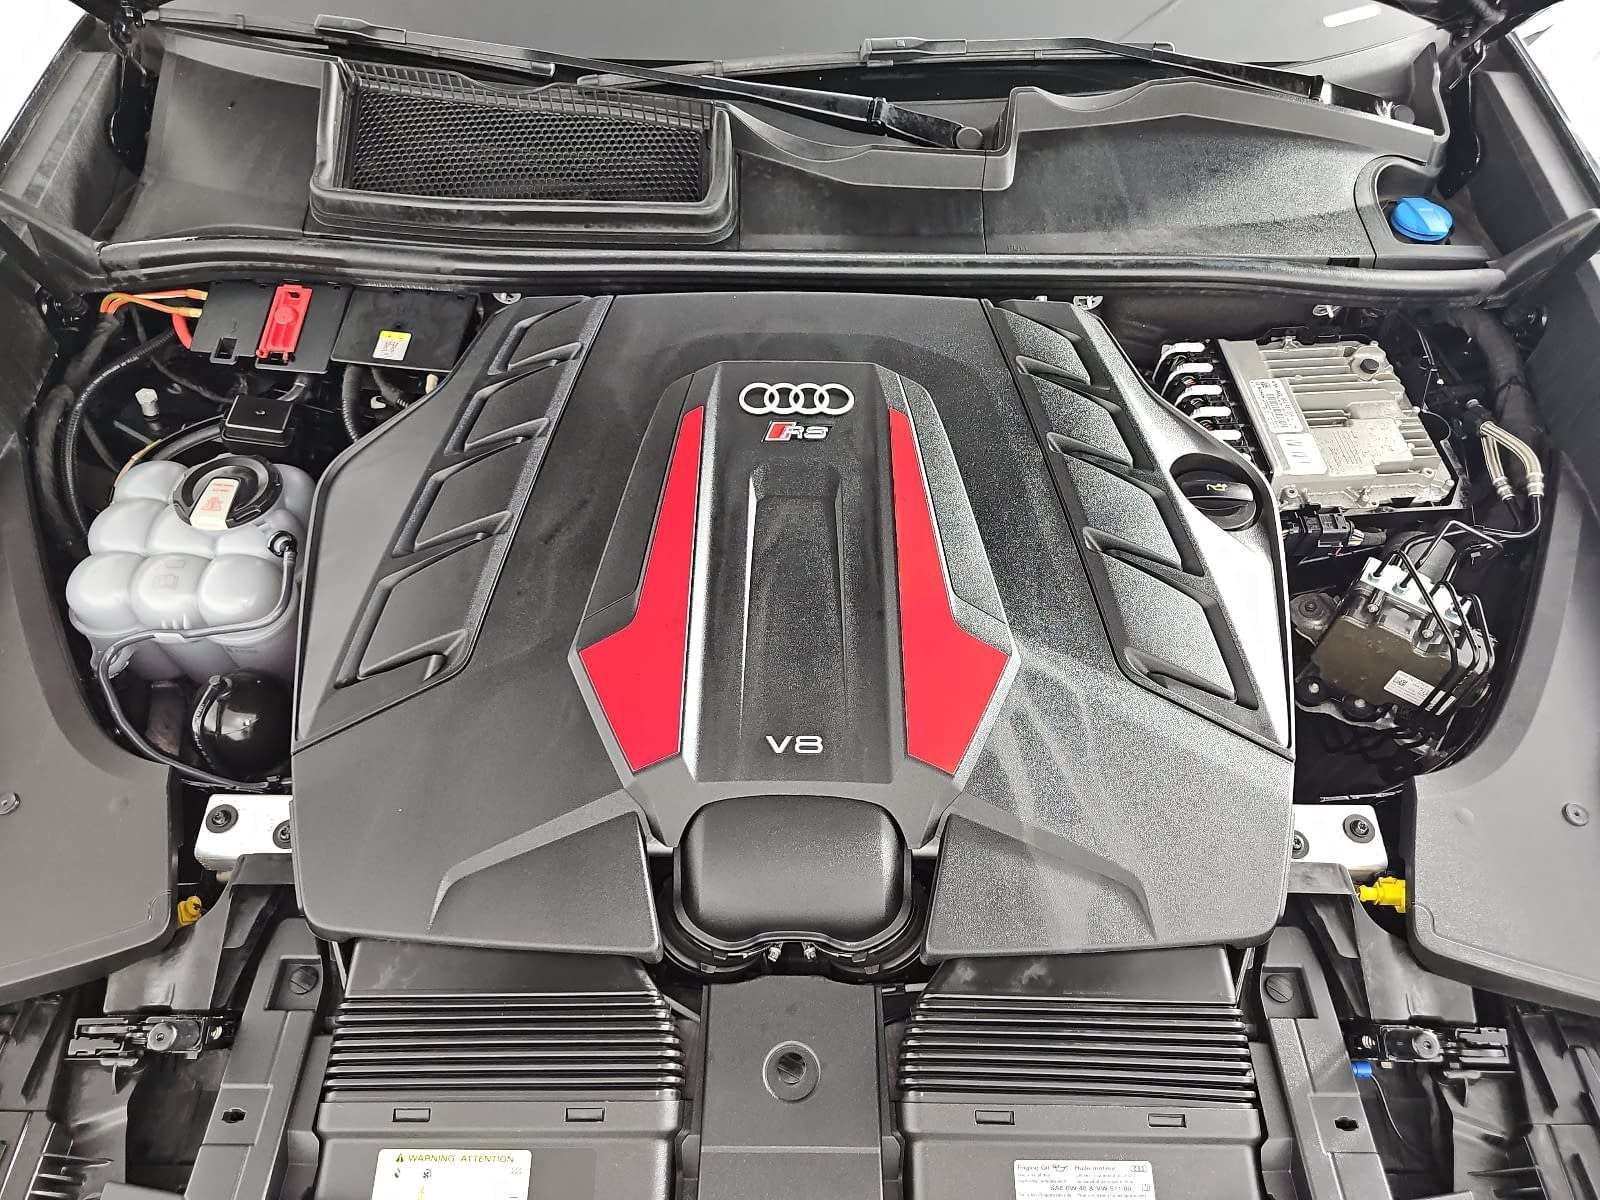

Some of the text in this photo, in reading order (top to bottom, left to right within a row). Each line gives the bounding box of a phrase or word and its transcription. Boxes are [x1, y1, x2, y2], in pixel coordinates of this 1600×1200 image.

[779, 423, 829, 440] RS
[765, 735, 824, 754] V8
[407, 1154, 514, 1163] WARNING ATTENTION
